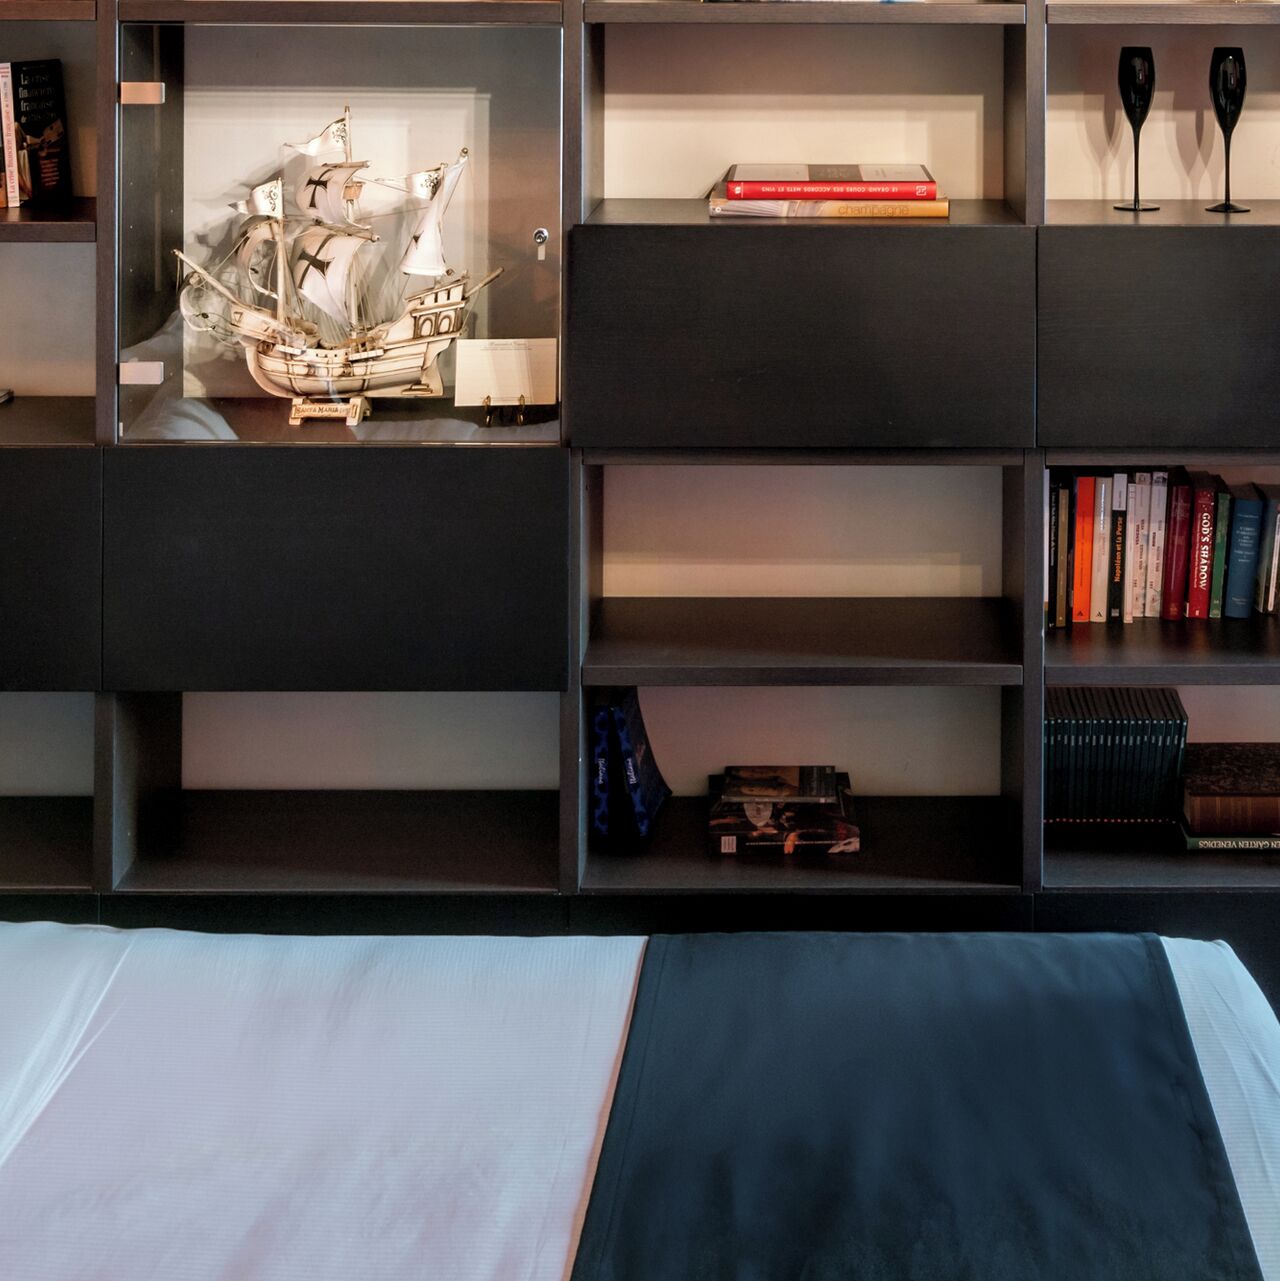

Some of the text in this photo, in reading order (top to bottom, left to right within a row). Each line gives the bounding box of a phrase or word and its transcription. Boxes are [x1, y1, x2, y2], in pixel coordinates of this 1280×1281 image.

[6, 169, 14, 183] crise
[7, 184, 15, 193] La
[839, 203, 909, 216] champagne
[1116, 516, 1124, 534] Perse
[1200, 512, 1210, 542] GOD'S
[1113, 551, 1122, 581] Napoléon
[1197, 545, 1208, 590] SHADOW
[1199, 840, 1237, 848] VENEDIGS
